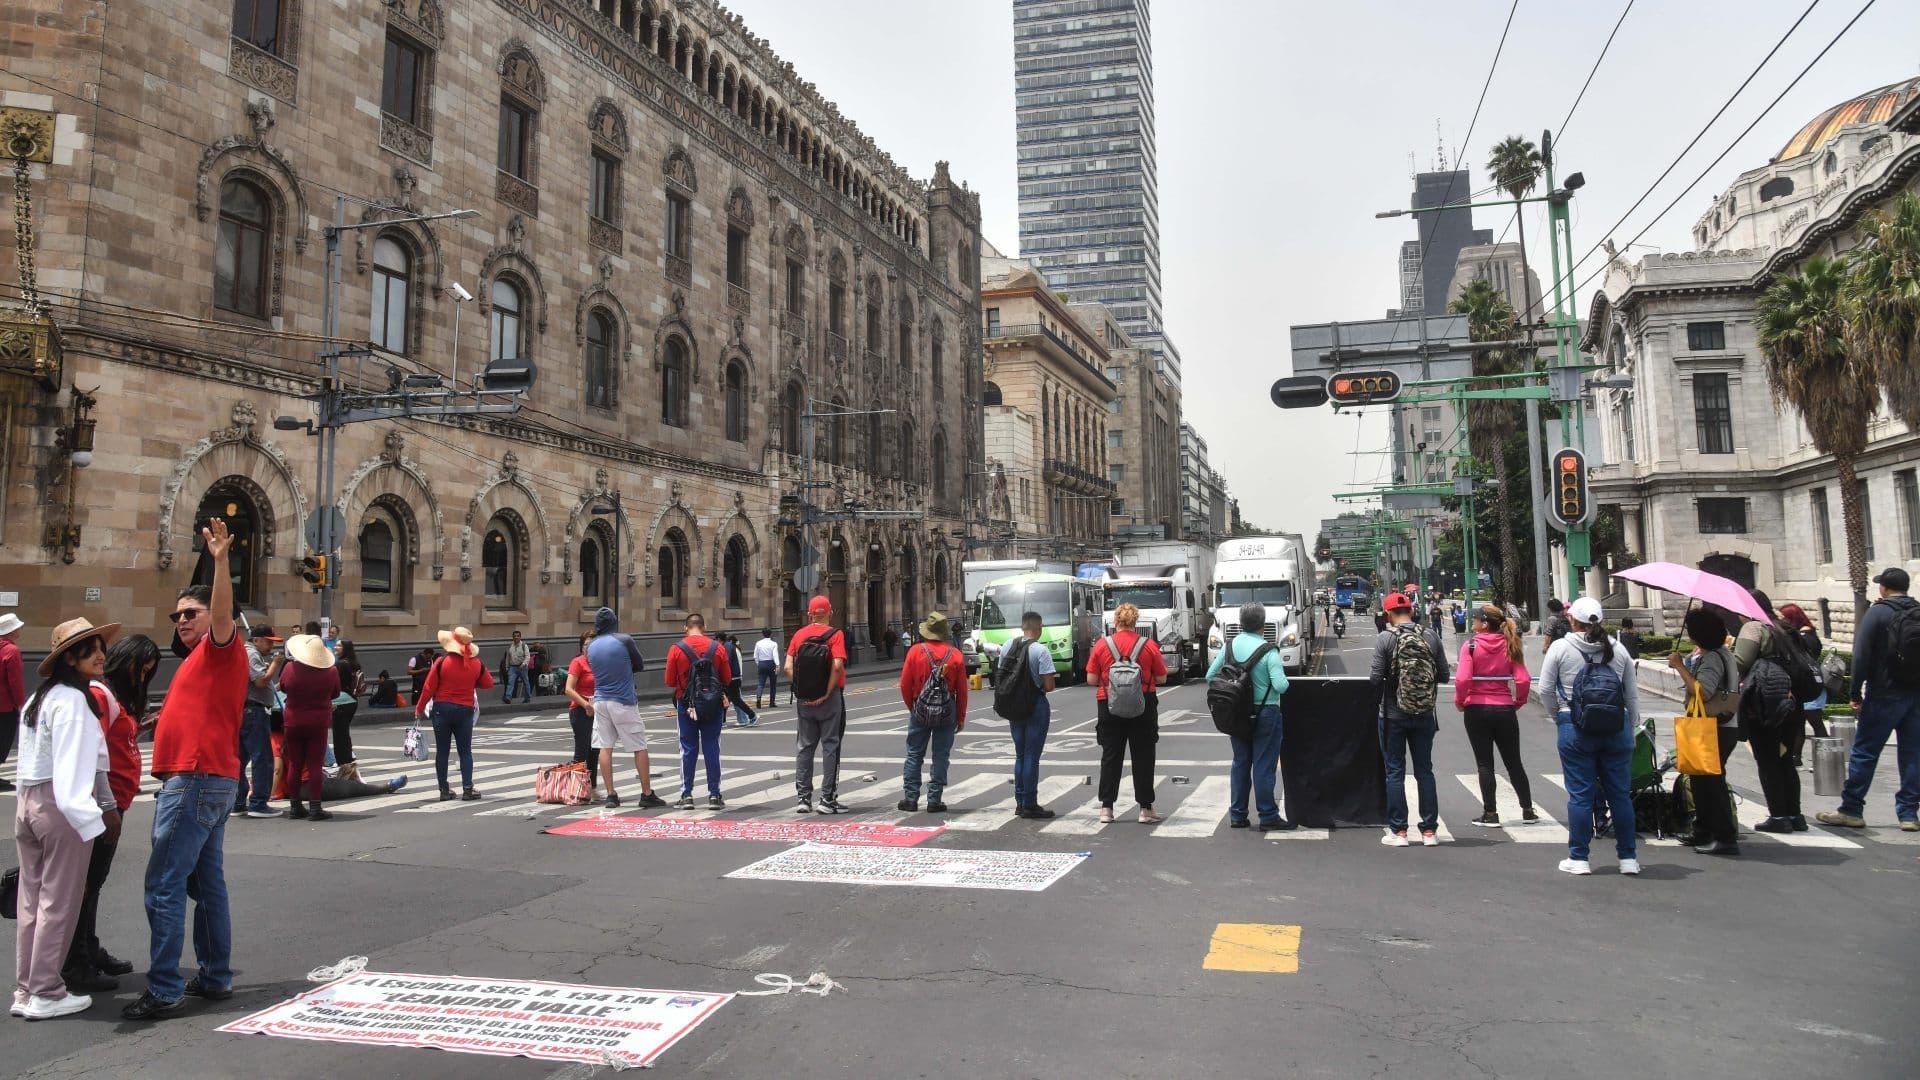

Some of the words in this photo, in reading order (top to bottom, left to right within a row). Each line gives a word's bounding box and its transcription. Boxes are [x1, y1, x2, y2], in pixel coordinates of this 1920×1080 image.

[347, 978, 379, 986] LA
[377, 980, 481, 993] ESCUELA
[480, 985, 532, 996] SEC.
[534, 989, 560, 998] N.
[565, 992, 613, 1002] 134
[614, 994, 660, 1005] T.M
[306, 1006, 344, 1016] POR
[485, 1020, 512, 1029] DE
[510, 1022, 534, 1031] LA
[389, 1005, 441, 1014] PARO
[440, 1007, 534, 1021] NACIONAL
[534, 1014, 664, 1031] MAGISTERIAL
[477, 1028, 564, 1043] SALARIOS
[561, 1036, 622, 1047] JUSTO
